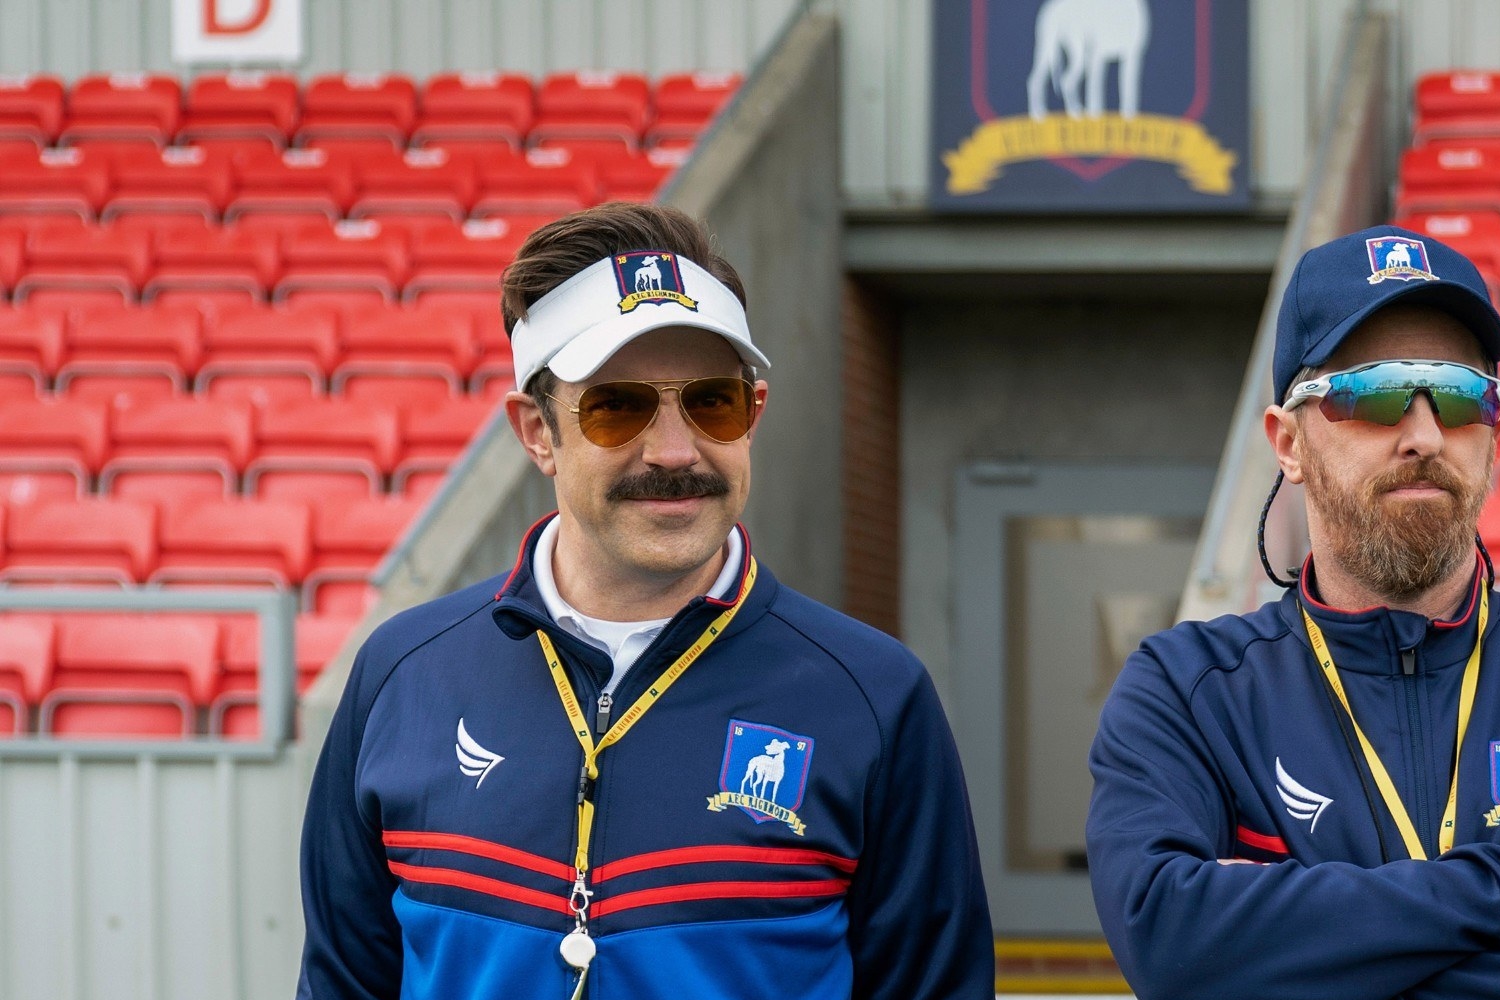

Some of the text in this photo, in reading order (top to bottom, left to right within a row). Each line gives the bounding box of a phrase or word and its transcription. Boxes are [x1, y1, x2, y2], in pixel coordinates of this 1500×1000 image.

[678, 645, 702, 669] RICHMOND
[617, 705, 642, 730] RICHMOND
[748, 796, 790, 821] RICHMOND
